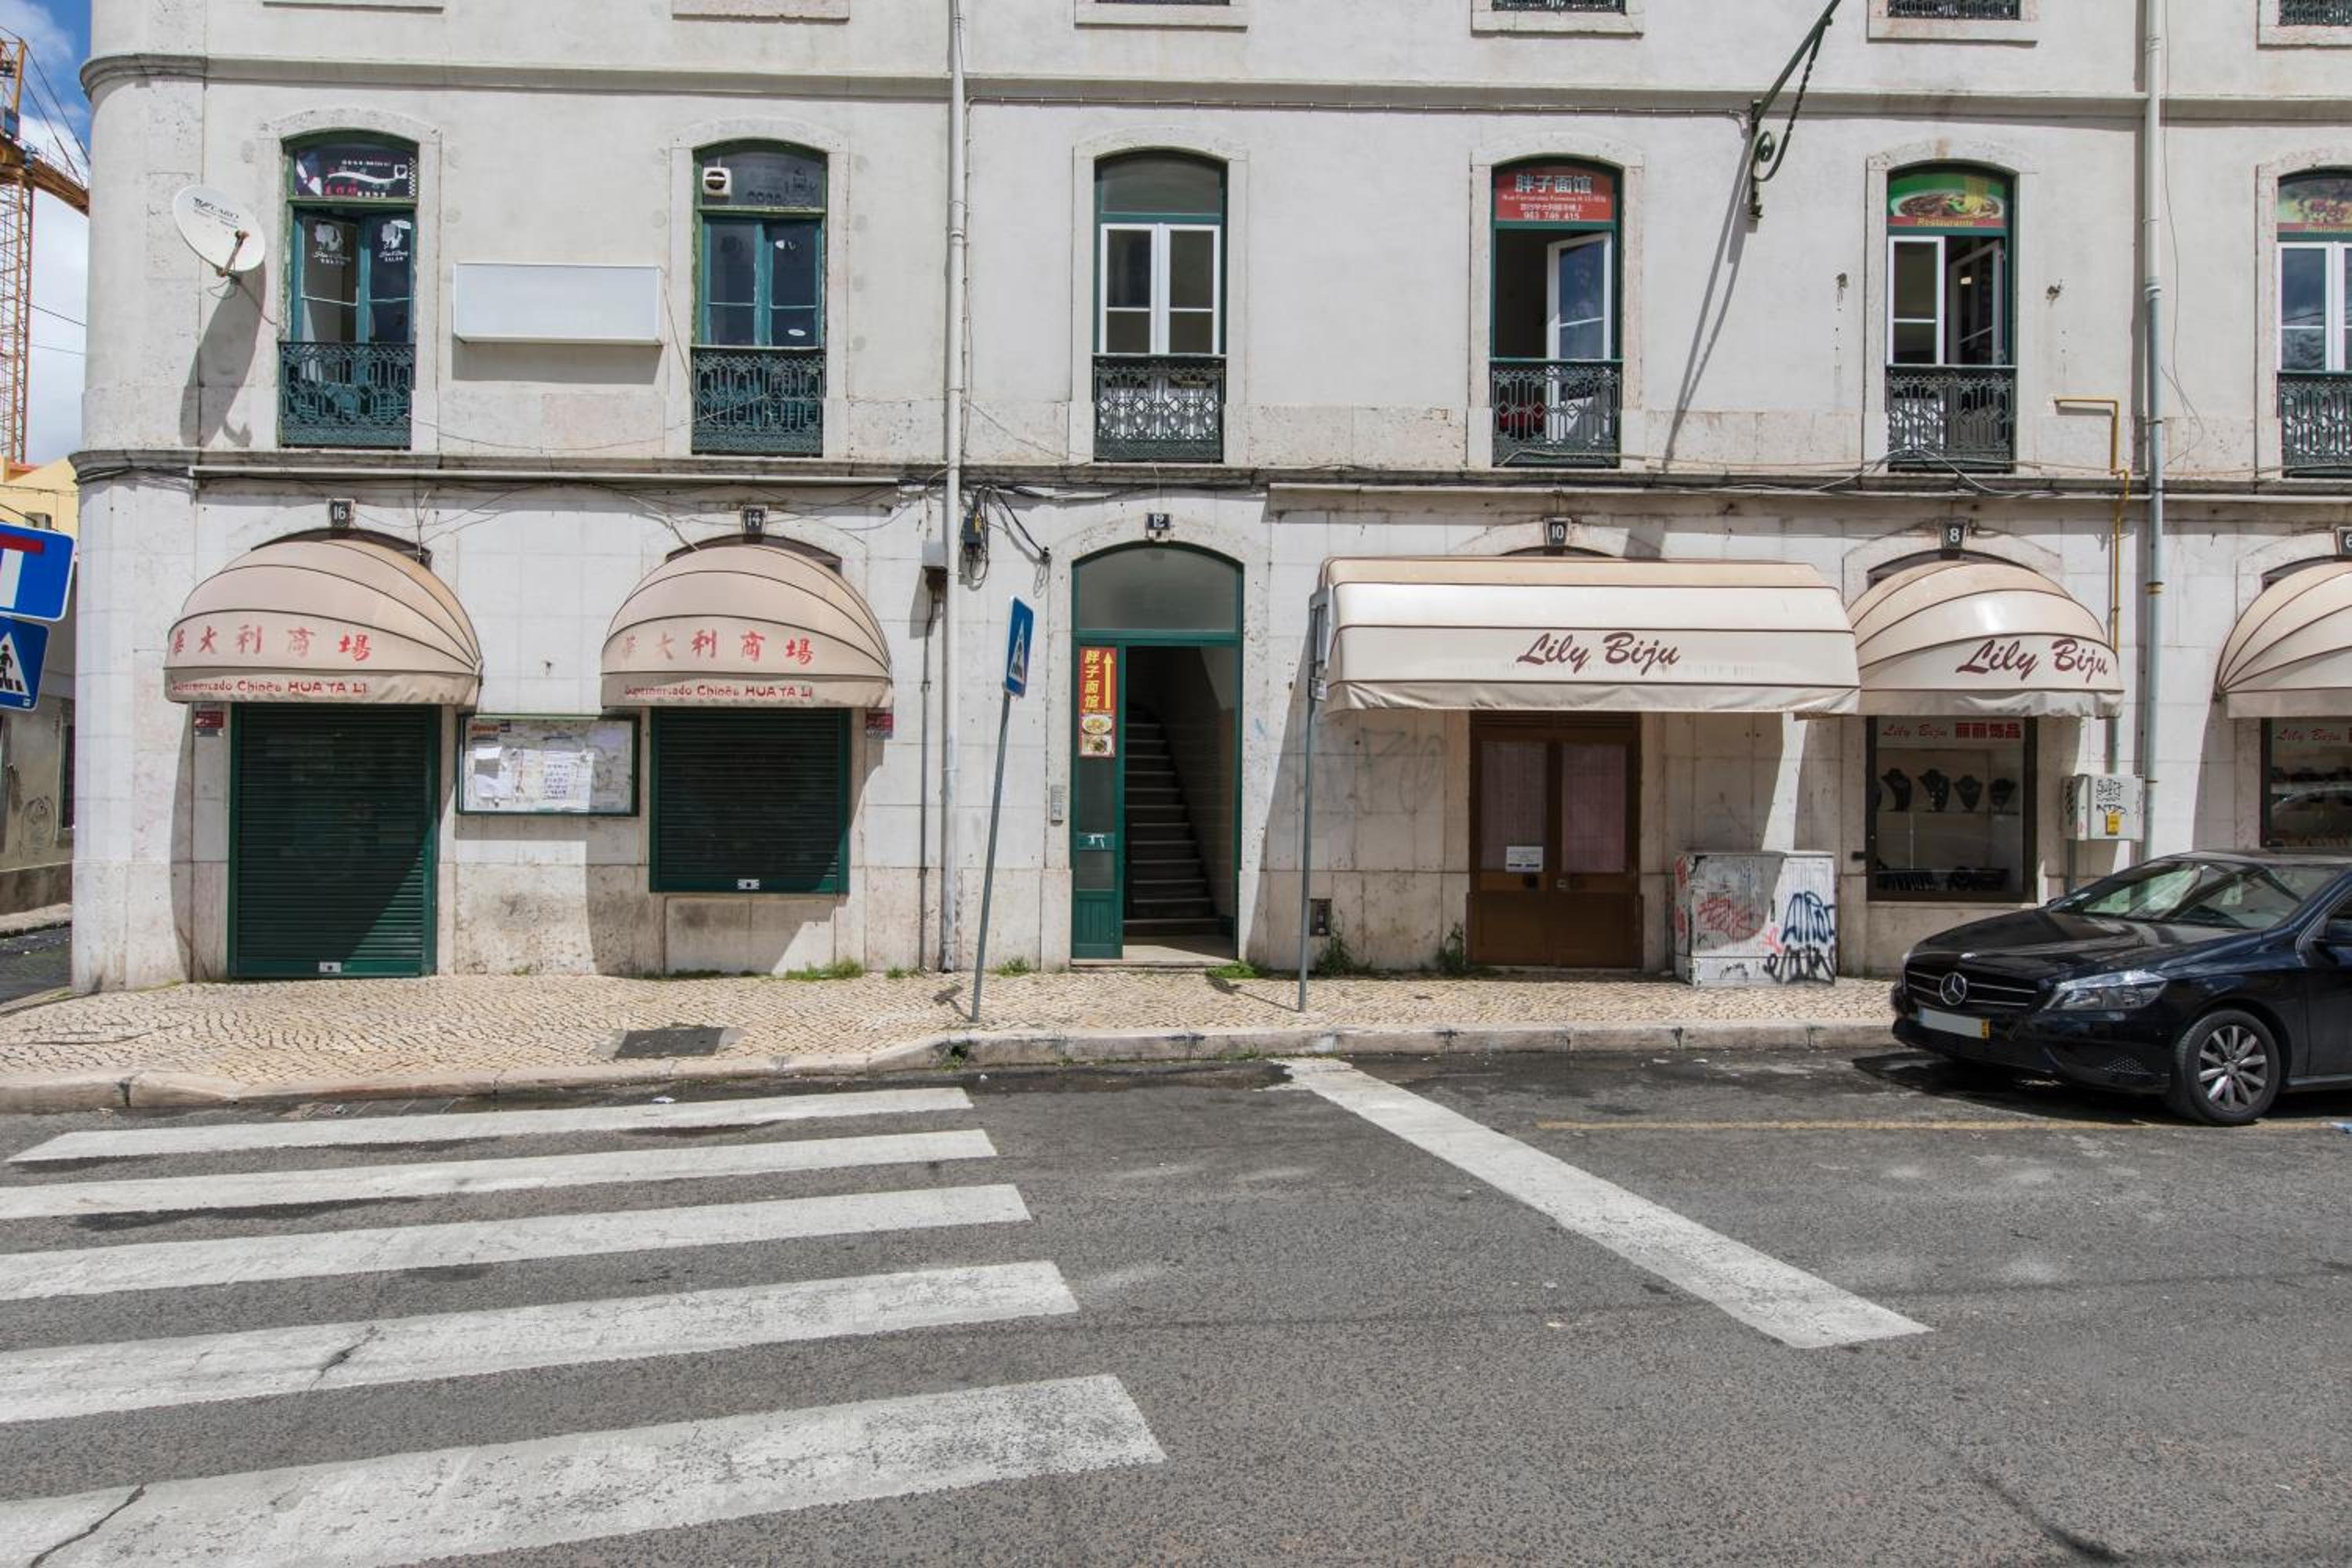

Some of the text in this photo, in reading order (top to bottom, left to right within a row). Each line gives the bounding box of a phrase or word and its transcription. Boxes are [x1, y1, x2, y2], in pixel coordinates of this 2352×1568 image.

[334, 505, 347, 520] 16
[747, 512, 761, 526] 14
[1552, 524, 1565, 539] 10
[1950, 528, 1960, 543] 8
[1516, 631, 1681, 676] Lily Biju
[1955, 638, 2108, 684] Lily Biju
